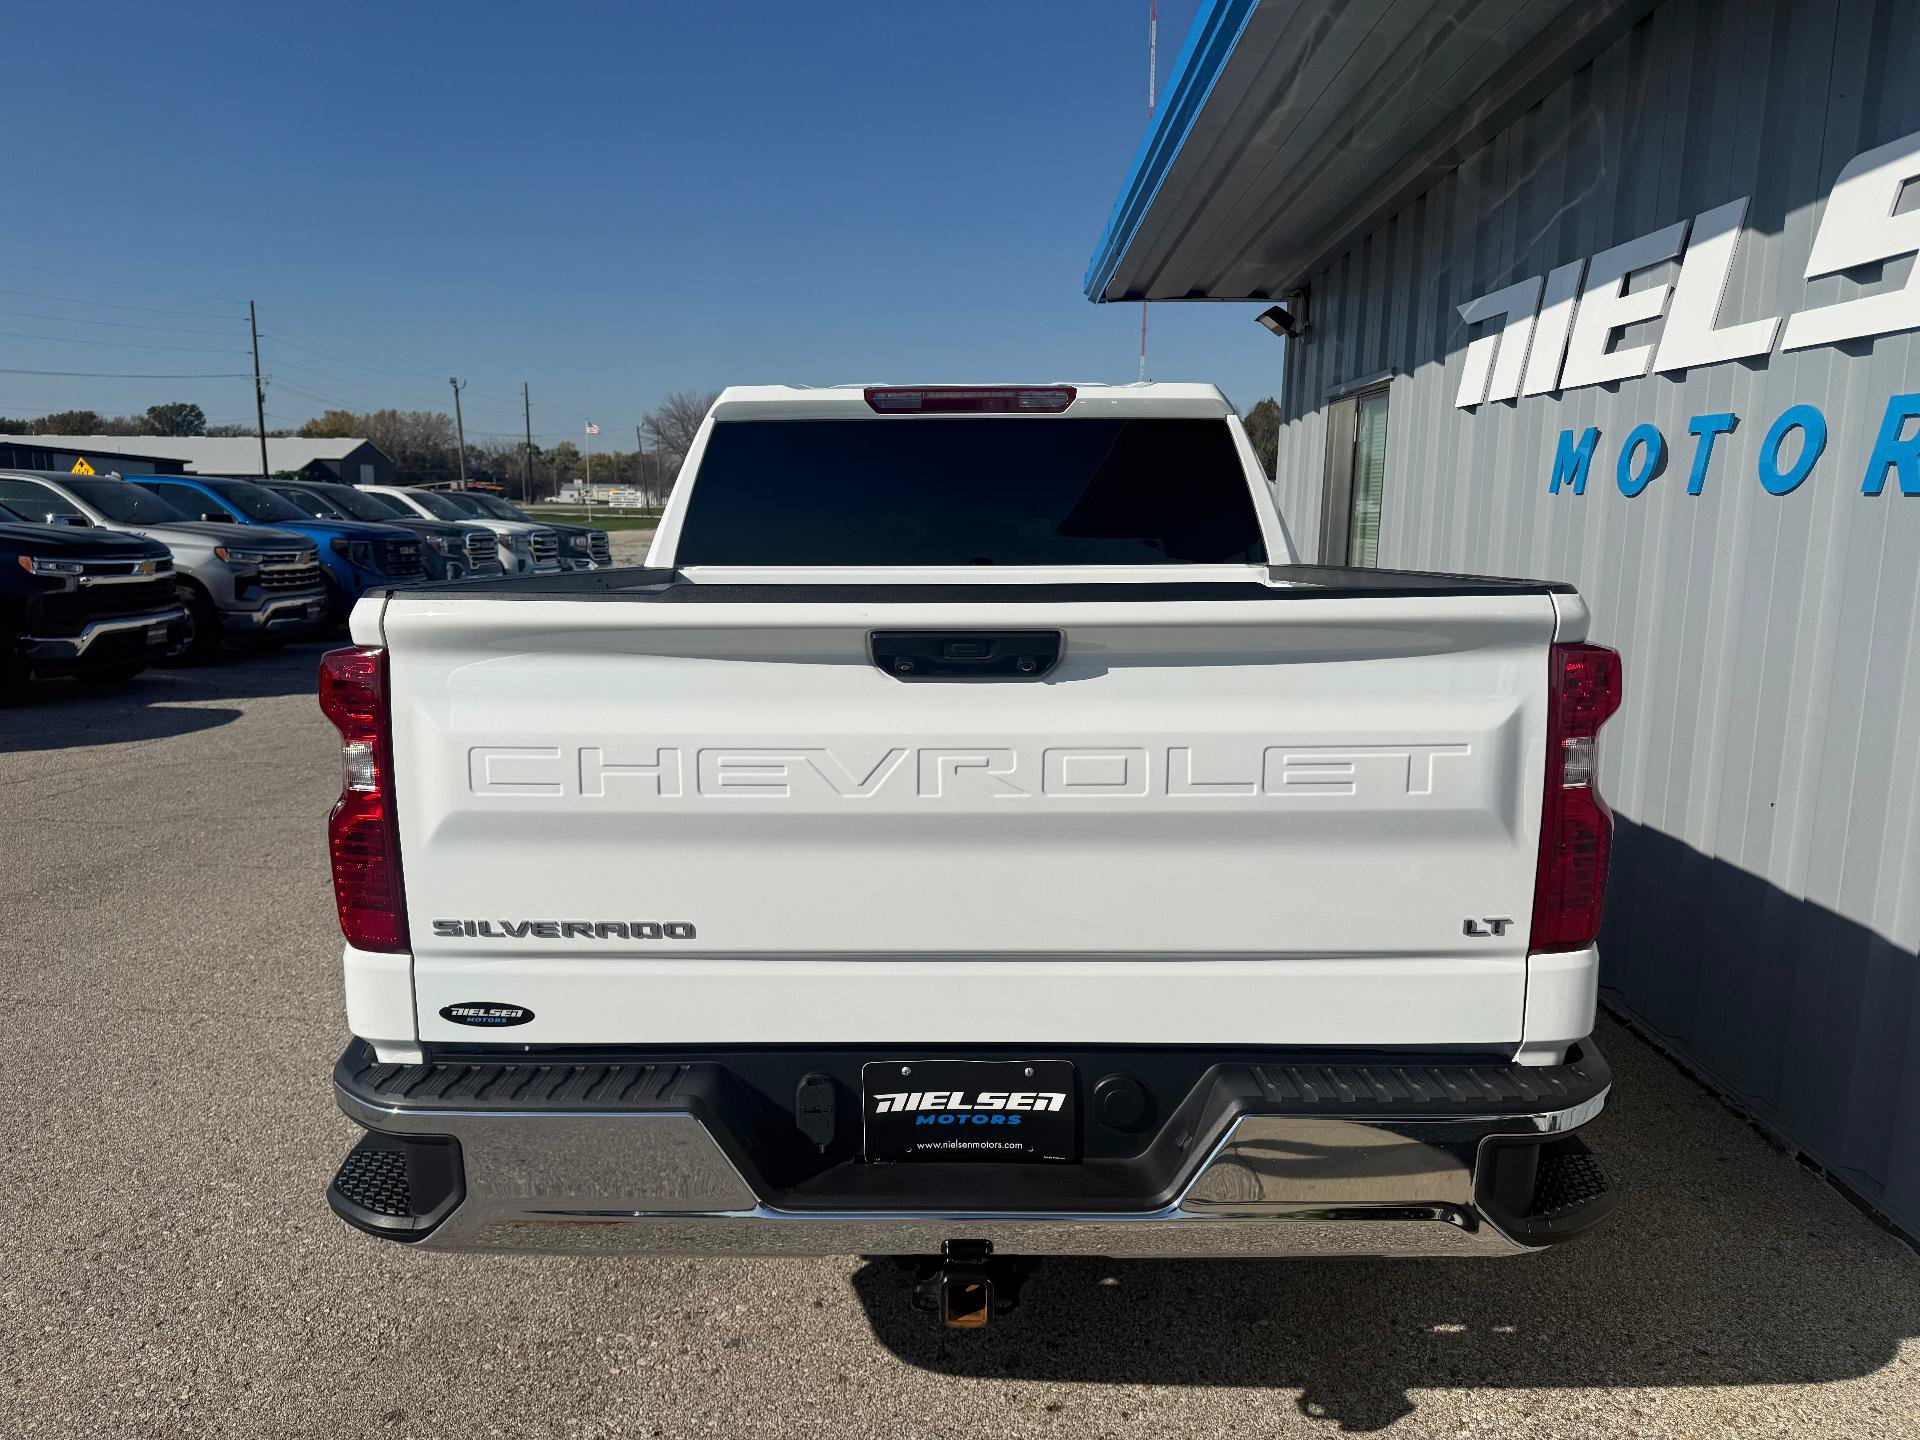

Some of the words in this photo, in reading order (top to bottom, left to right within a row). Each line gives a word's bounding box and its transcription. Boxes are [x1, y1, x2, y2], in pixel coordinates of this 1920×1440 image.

[468, 743, 1472, 799] CHEVROLET
[432, 919, 697, 940] SILVERADO
[1462, 915, 1515, 938] LT
[450, 1007, 524, 1018] NIELSEN
[466, 1016, 507, 1024] MOTORS
[872, 1091, 1066, 1113] NIELSEN
[915, 1114, 1022, 1125] MOTORS
[916, 1138, 1023, 1150] www.nielsenmotors.com
